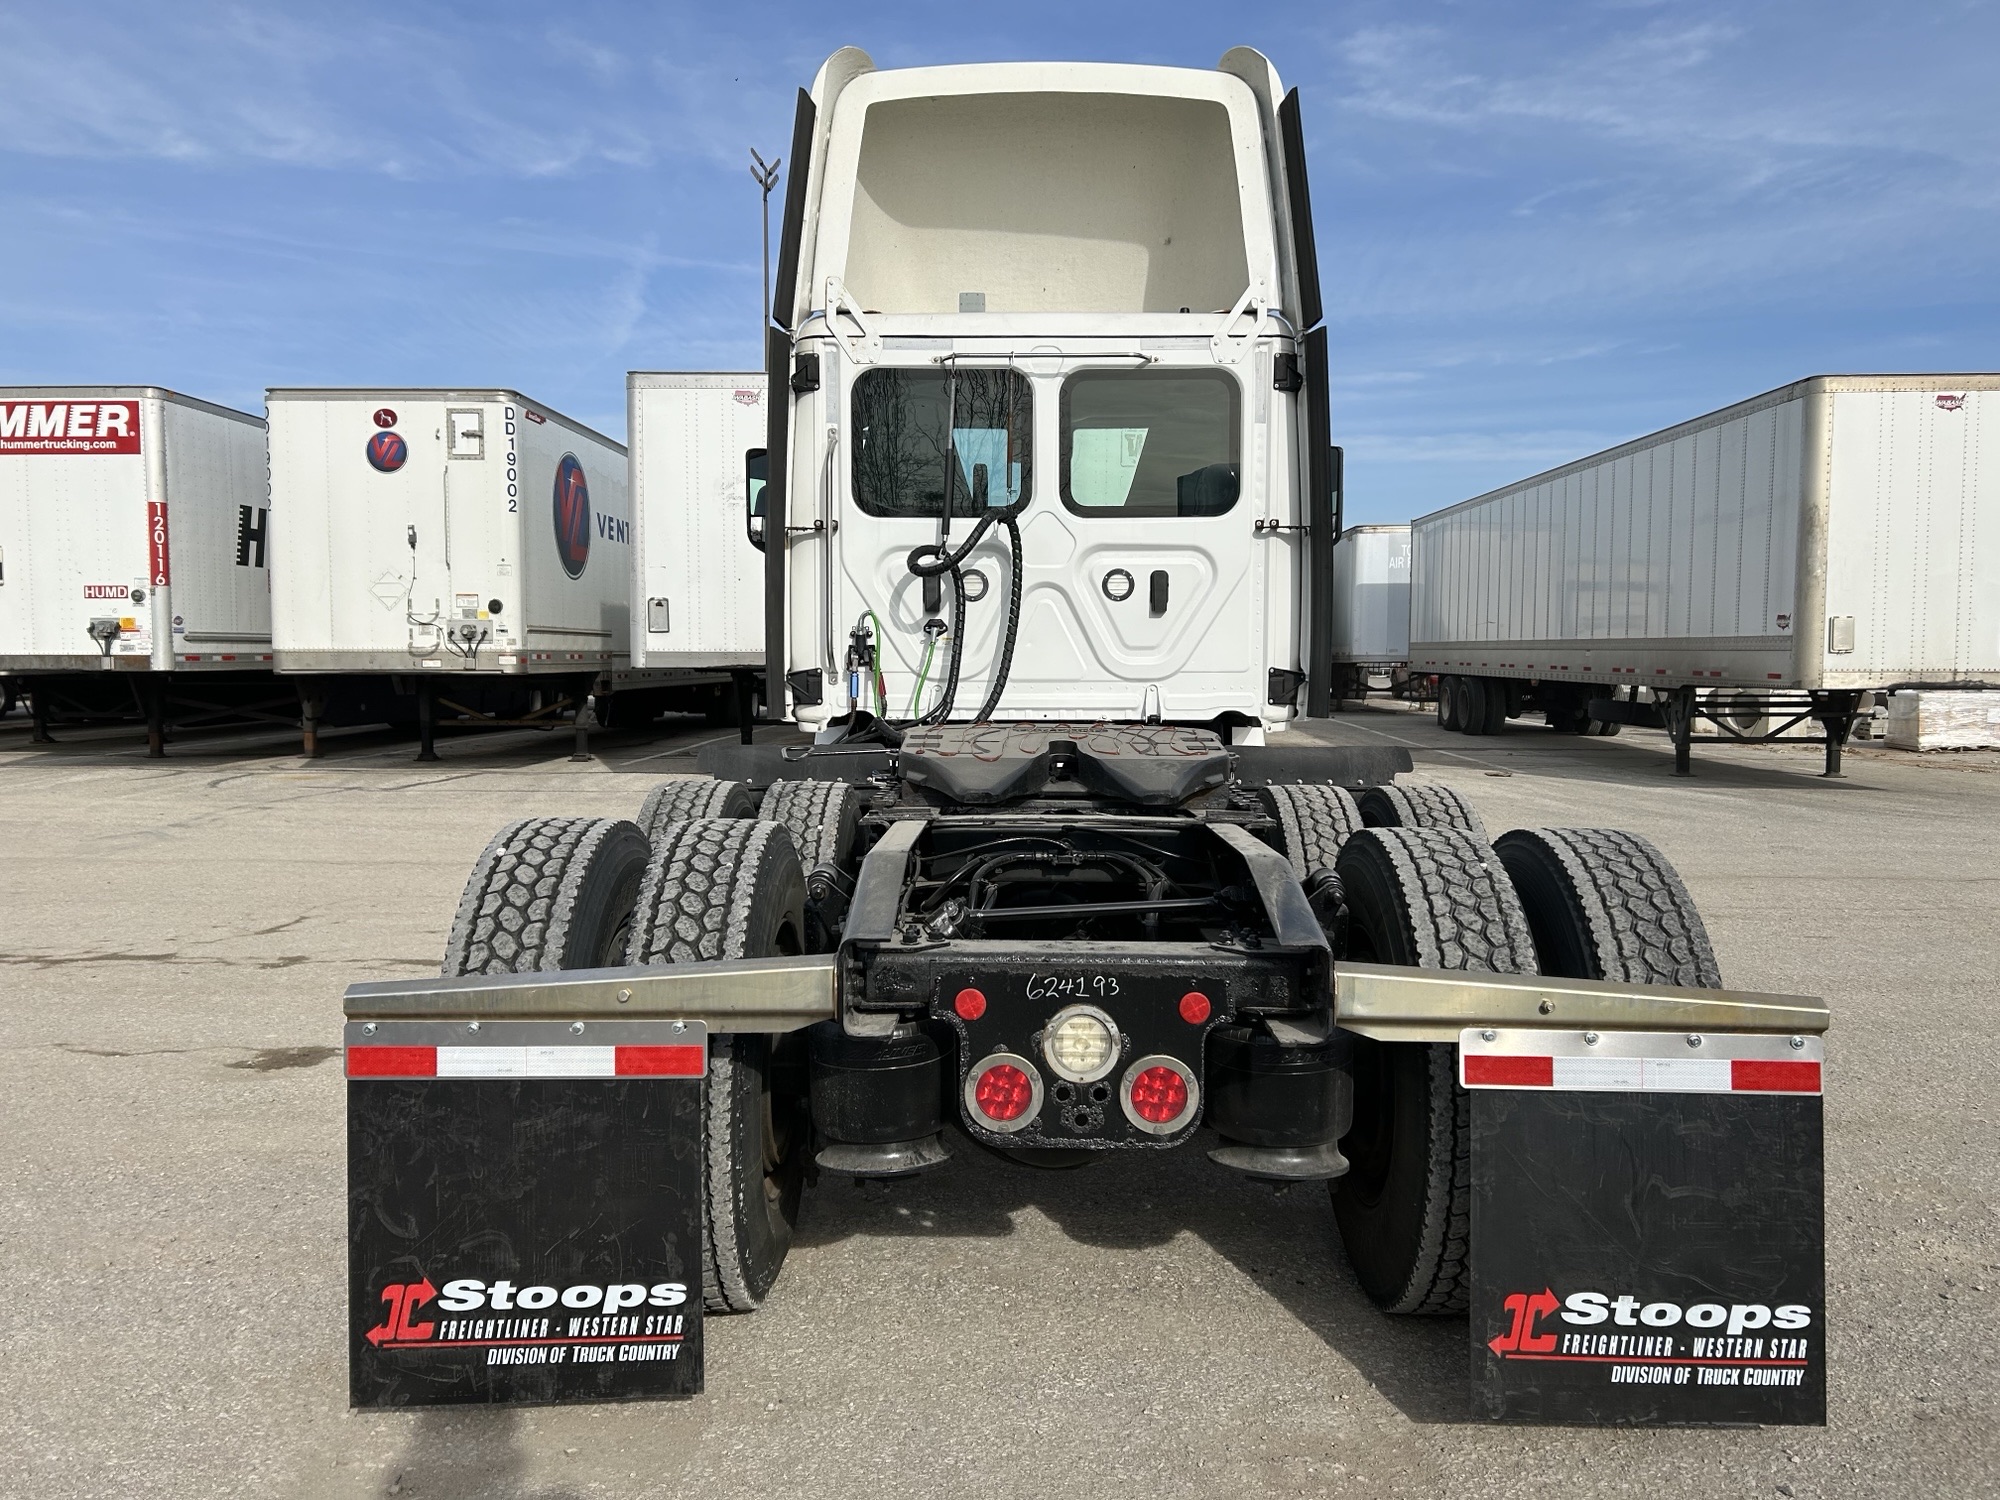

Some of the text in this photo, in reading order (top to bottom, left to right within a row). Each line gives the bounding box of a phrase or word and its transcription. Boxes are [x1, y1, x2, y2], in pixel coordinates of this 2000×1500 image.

[1, 439, 117, 451] hummertrucking.com
[504, 406, 518, 513] DD19002
[153, 503, 166, 586] 120116
[1389, 557, 1404, 569] AIR
[84, 586, 128, 598] HUMD
[1026, 973, 1120, 1000] 624193
[437, 1279, 688, 1314] Stoops
[1560, 1291, 1811, 1335] Stoops
[438, 1318, 549, 1340] FREIGHTLINER
[568, 1315, 638, 1338] WESTERN
[645, 1315, 684, 1335] STAR
[487, 1344, 681, 1365] DIVISION OF TRUCK COUNTRY
[1562, 1333, 1674, 1357] FREIGHTLINER
[1692, 1336, 1763, 1359] WESTERN
[1769, 1338, 1808, 1360] STAR
[1611, 1366, 1805, 1387] DIVISION OF TRUCK COUNTRY
